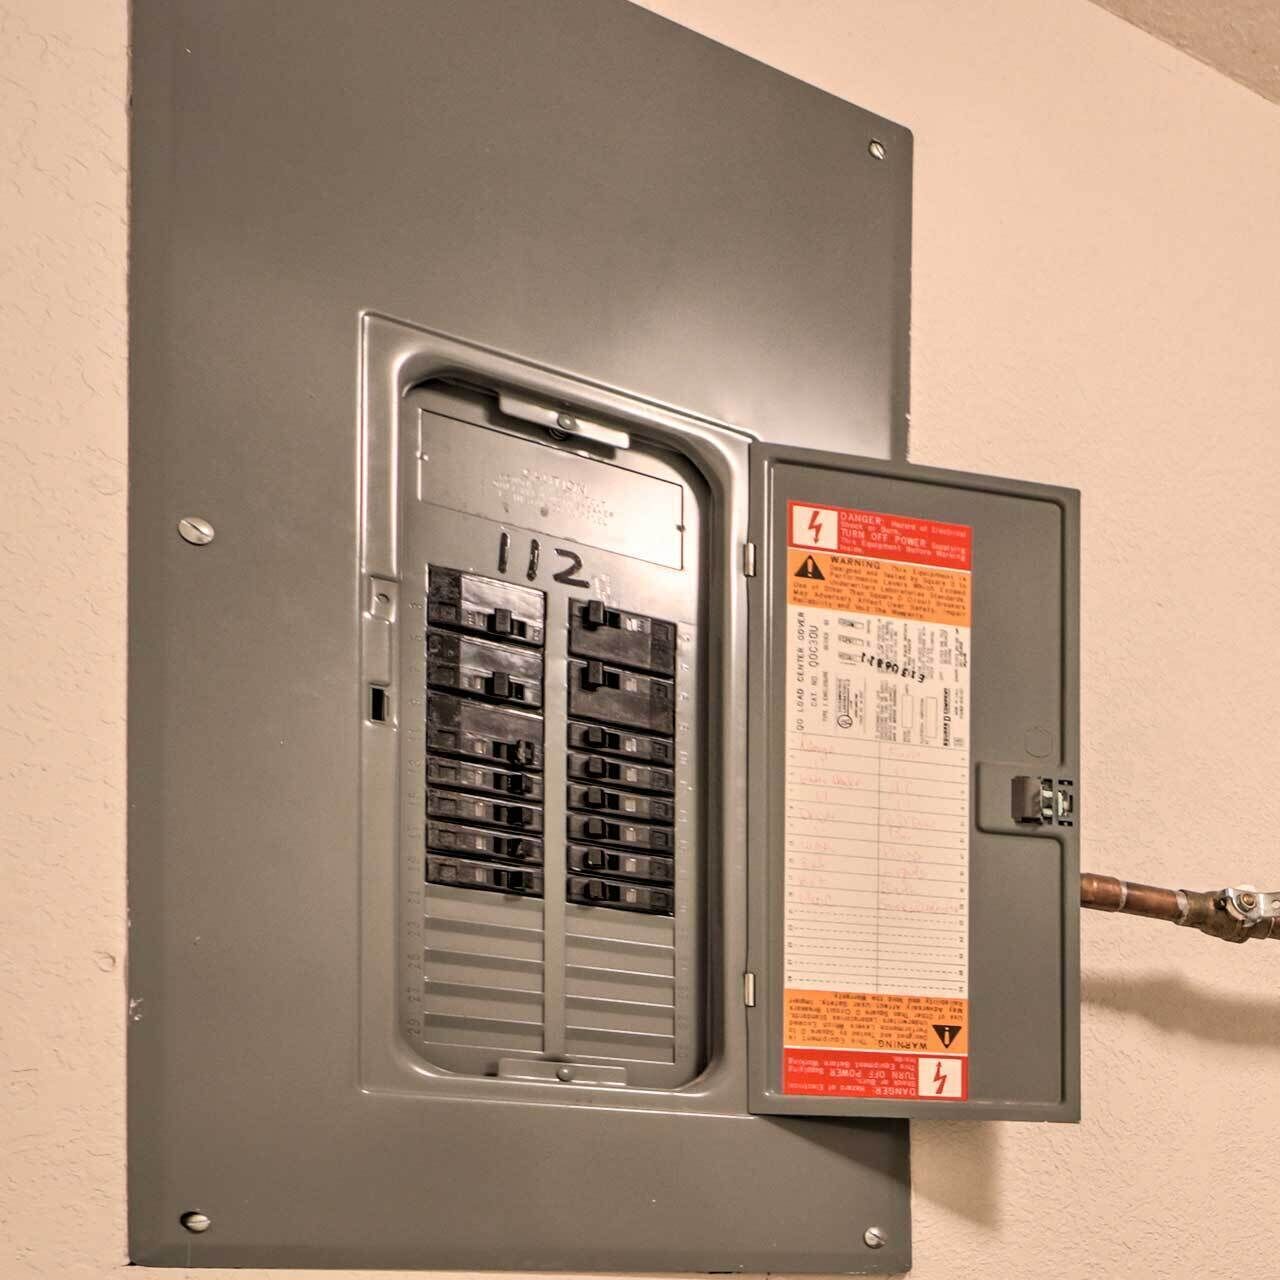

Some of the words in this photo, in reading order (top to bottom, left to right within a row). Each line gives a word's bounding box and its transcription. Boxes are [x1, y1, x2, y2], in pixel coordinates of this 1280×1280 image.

[841, 528, 865, 539] TURN
[871, 532, 888, 541] OFF
[895, 535, 926, 546] POWER
[498, 532, 590, 589] 112
[797, 611, 805, 641] COVER
[797, 648, 805, 682] CENTER
[796, 688, 805, 713] LOAD
[829, 1068, 862, 1078] POWER
[869, 1071, 886, 1079] OFF
[892, 1070, 916, 1080] TURN
